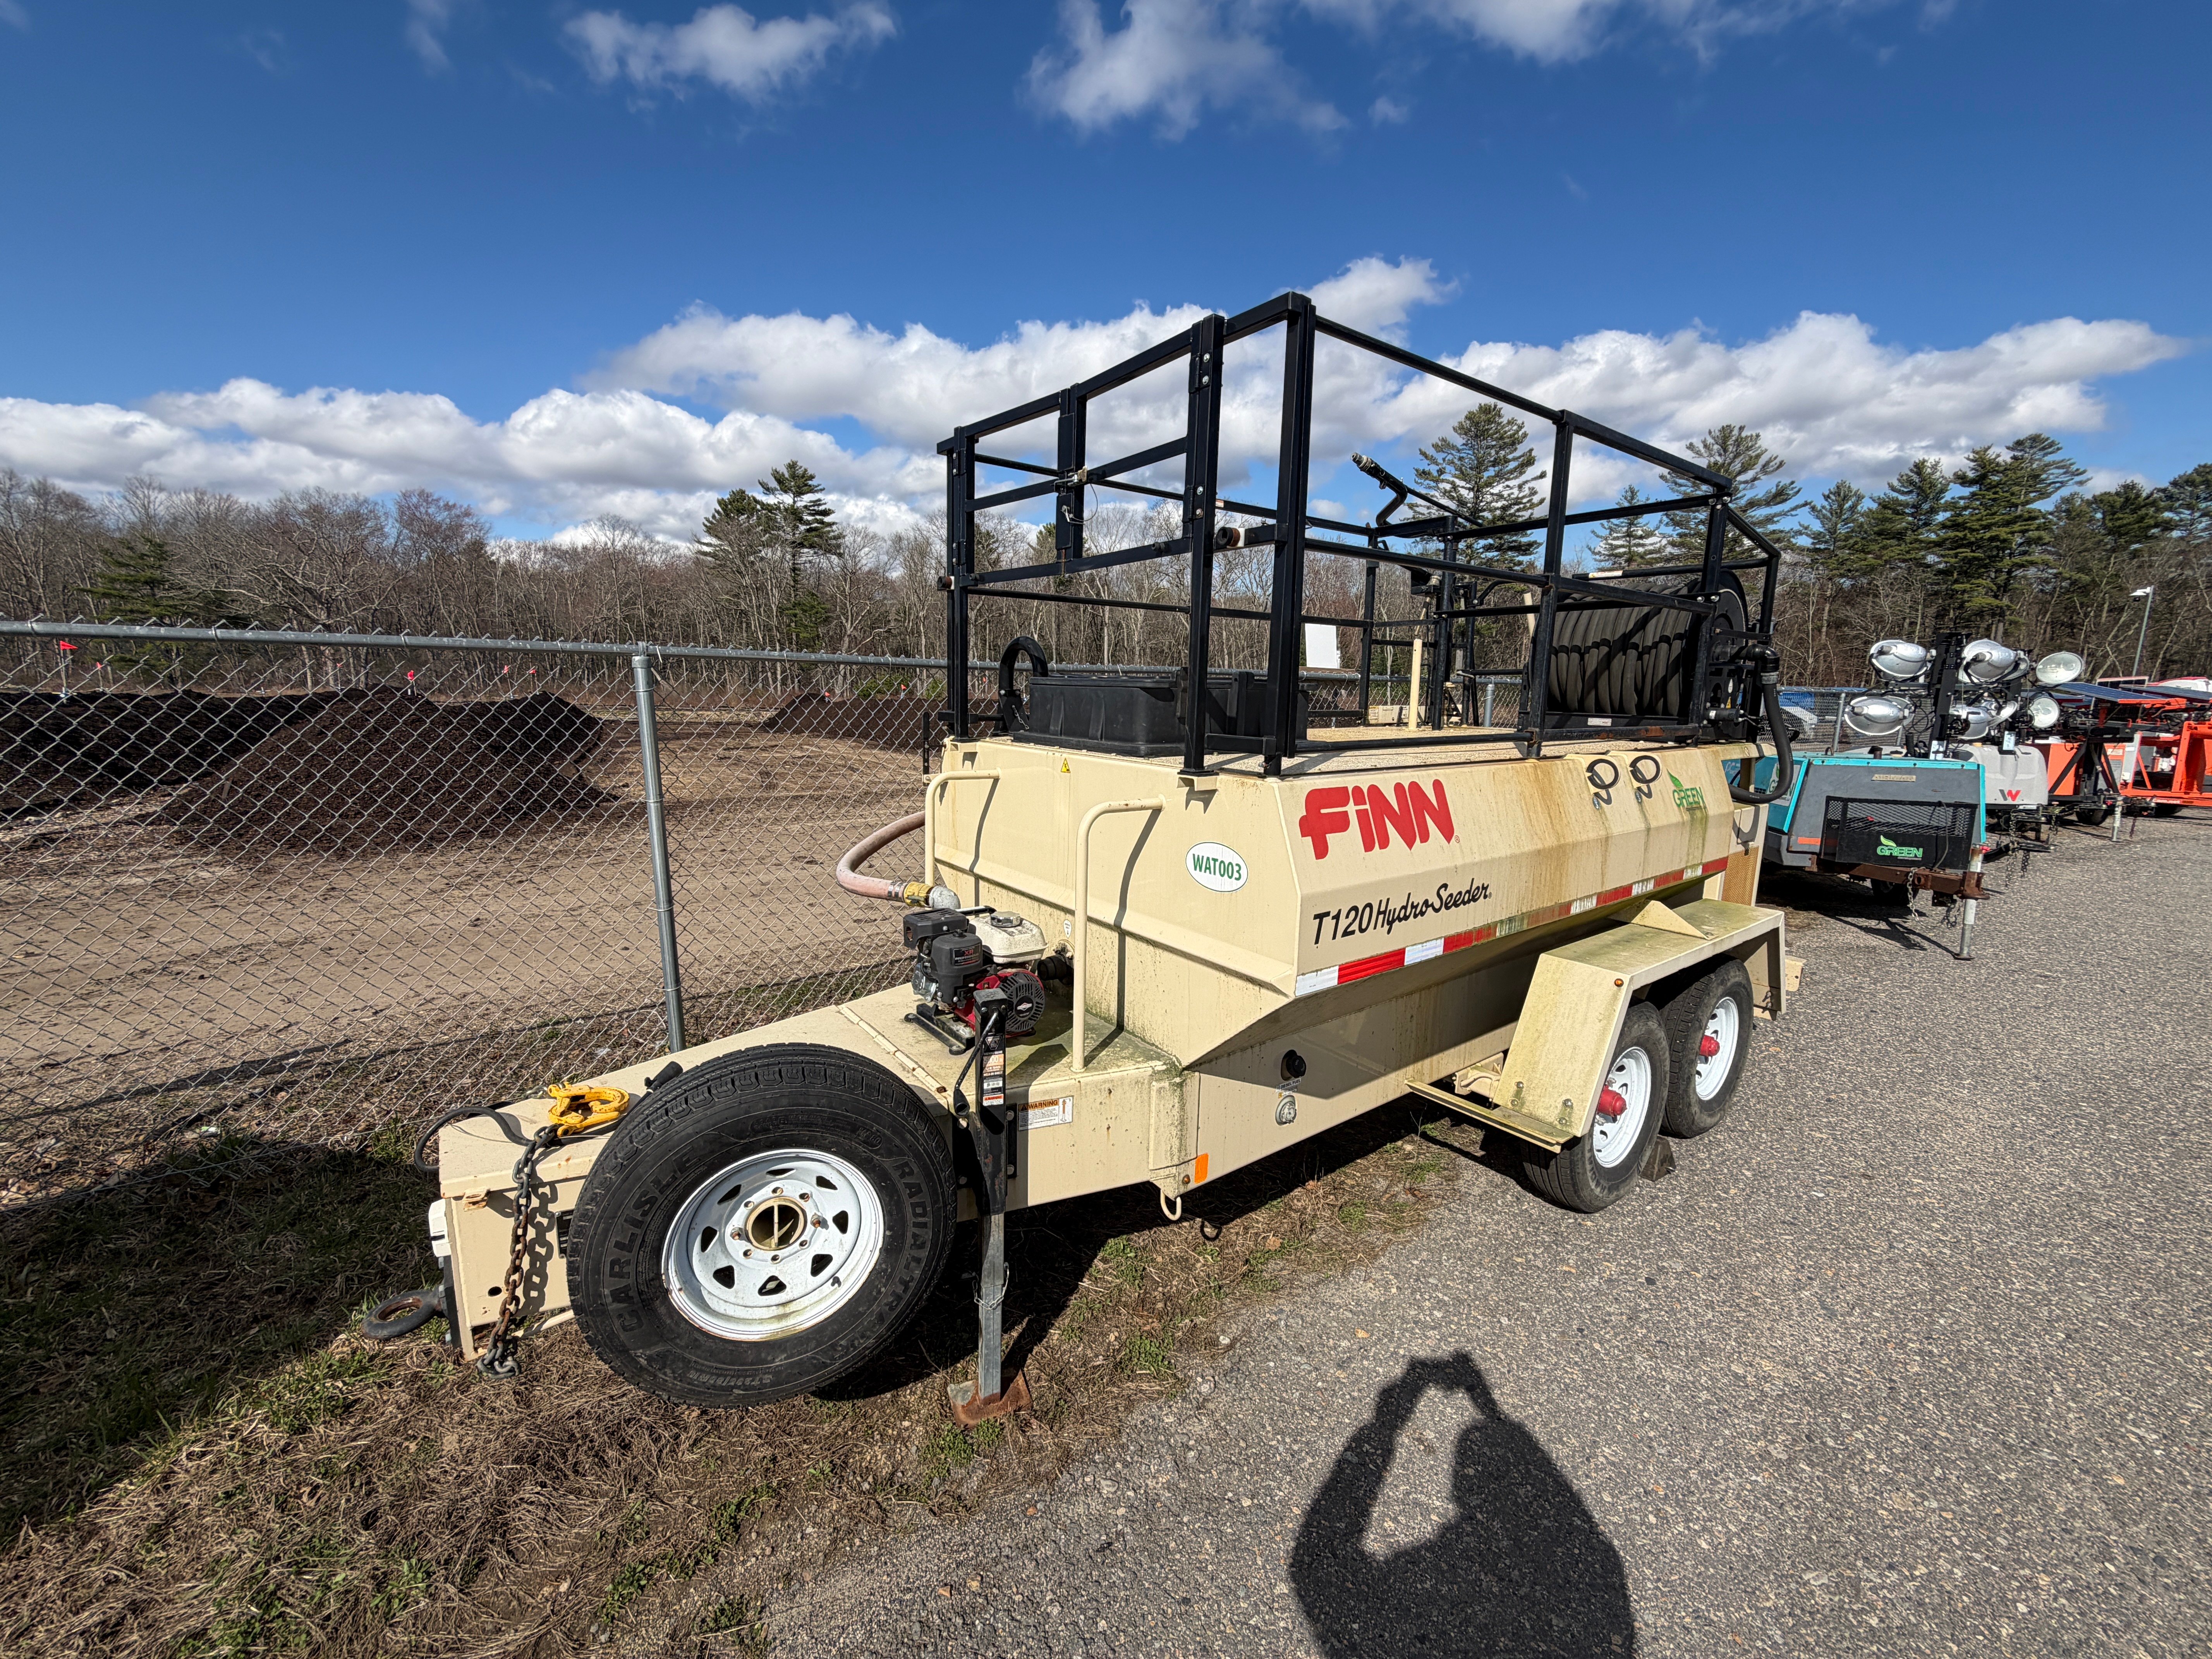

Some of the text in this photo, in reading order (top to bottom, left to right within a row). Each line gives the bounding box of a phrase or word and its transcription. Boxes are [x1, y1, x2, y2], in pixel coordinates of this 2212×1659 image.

[1673, 787, 1706, 808] GREEN
[1877, 845, 1923, 857] GREEN
[1192, 853, 1242, 881] WAT003
[1313, 902, 1373, 945] T120
[1027, 1100, 1058, 1109] WARNING
[892, 1161, 928, 1271] RADIAL
[609, 1146, 701, 1333] CARLISLE
